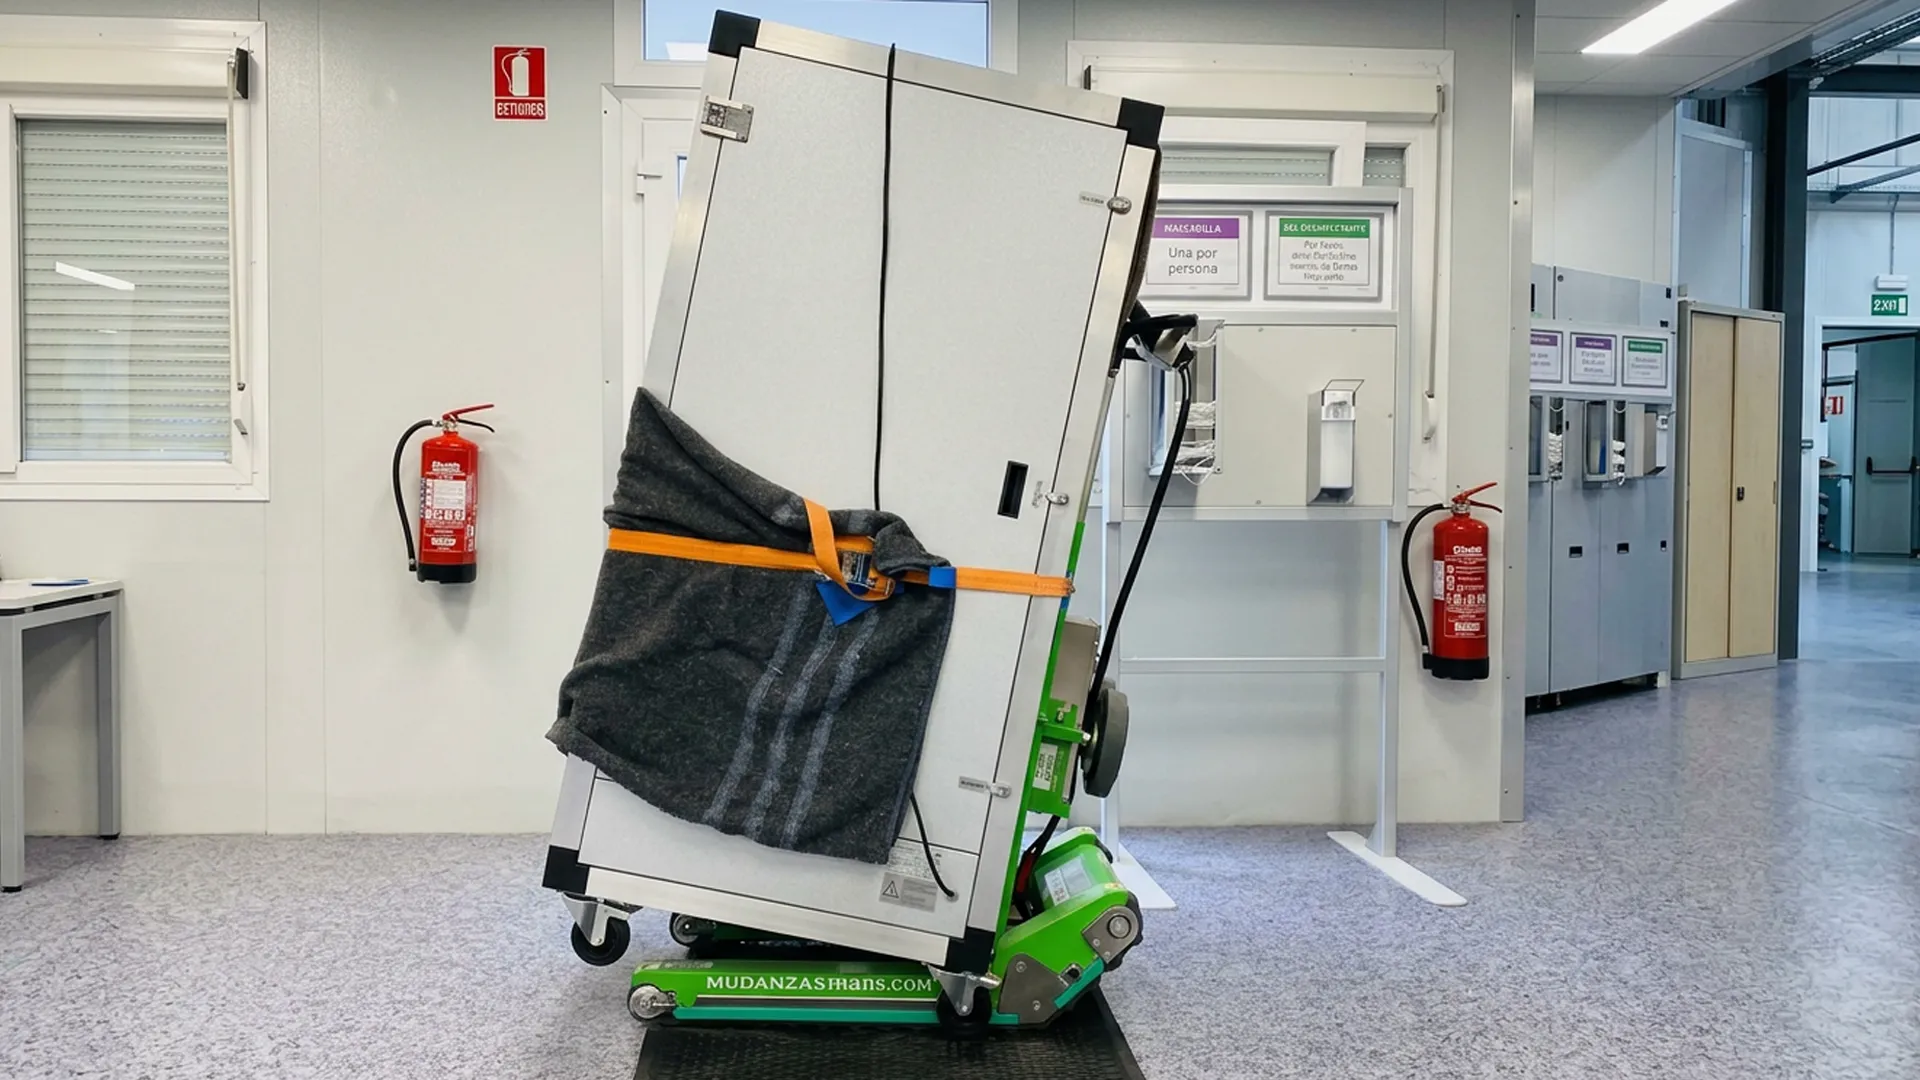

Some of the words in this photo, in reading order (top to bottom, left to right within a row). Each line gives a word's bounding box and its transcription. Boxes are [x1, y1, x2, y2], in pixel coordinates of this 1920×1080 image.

[1168, 247, 1193, 258] Una
[1196, 249, 1218, 260] por
[1168, 264, 1218, 276] persona
